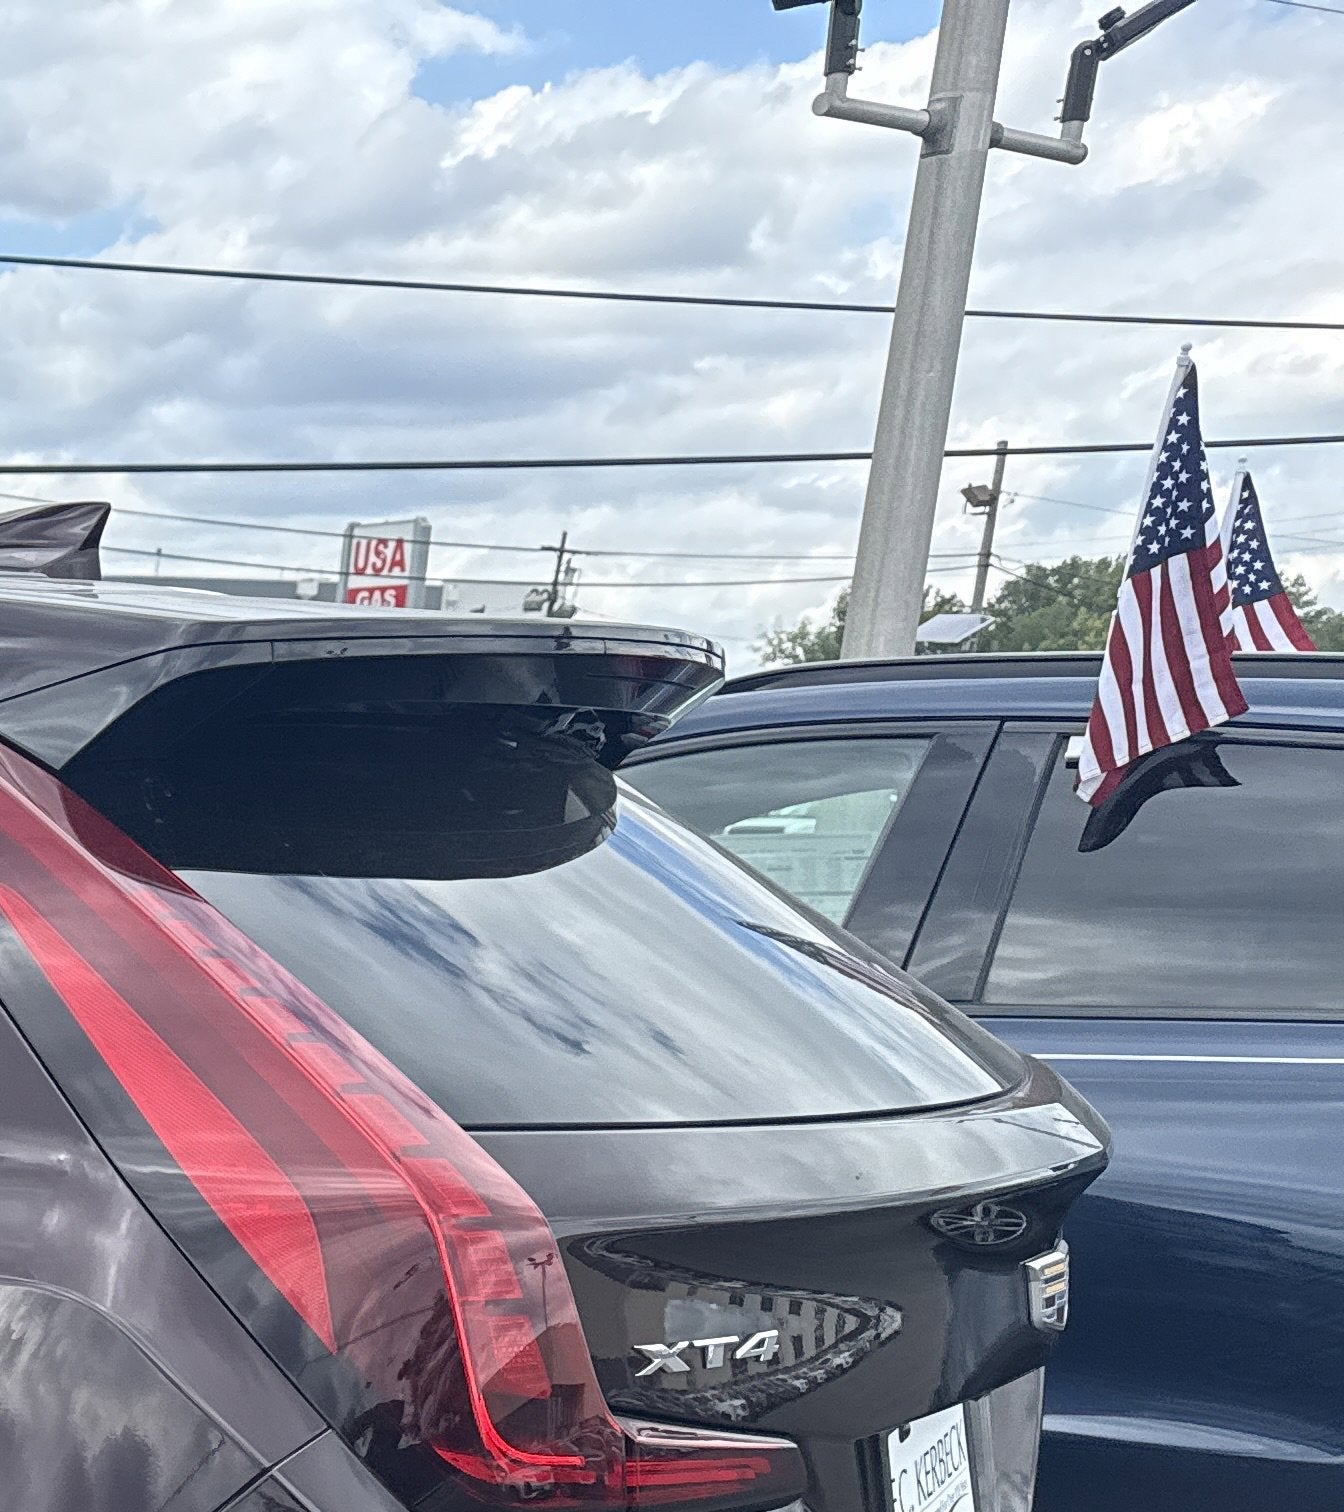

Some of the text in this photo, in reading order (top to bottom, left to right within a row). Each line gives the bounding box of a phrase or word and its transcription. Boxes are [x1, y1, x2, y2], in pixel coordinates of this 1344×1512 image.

[353, 536, 406, 576] USA
[355, 588, 397, 607] GAS
[633, 1329, 780, 1377] XT4
[914, 1419, 967, 1506] KERBECK
